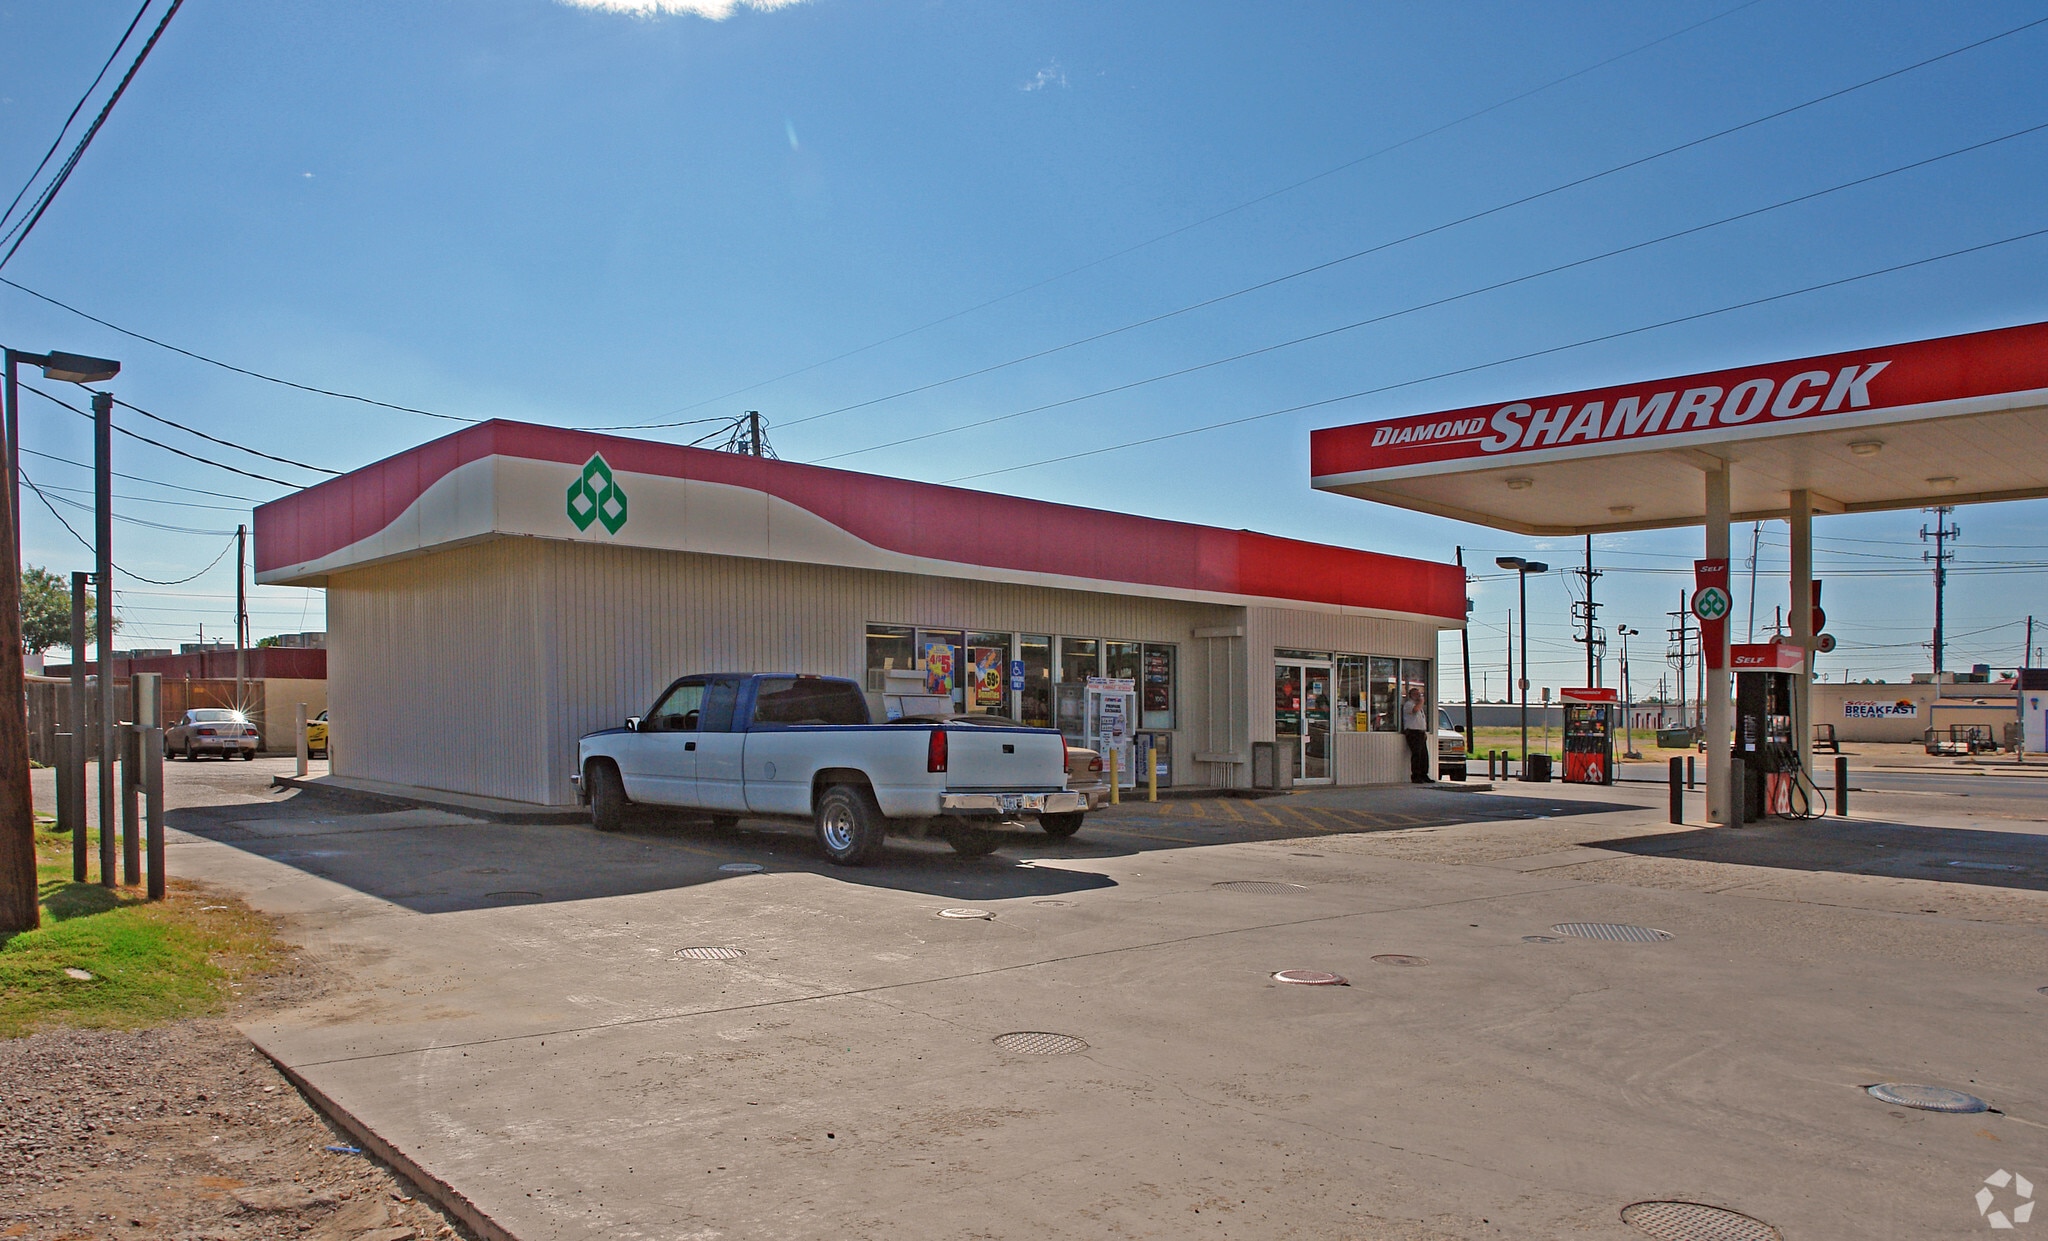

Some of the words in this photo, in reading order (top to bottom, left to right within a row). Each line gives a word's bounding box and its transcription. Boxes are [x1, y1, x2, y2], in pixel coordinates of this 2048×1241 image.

[1371, 417, 1485, 447] DIAMOND
[1480, 360, 1893, 452] SHAMROCK
[1700, 565, 1725, 573] SELF
[1821, 638, 1830, 647] 5
[1735, 656, 1765, 664] SELF
[1845, 706, 1916, 714] BREAKFAST
